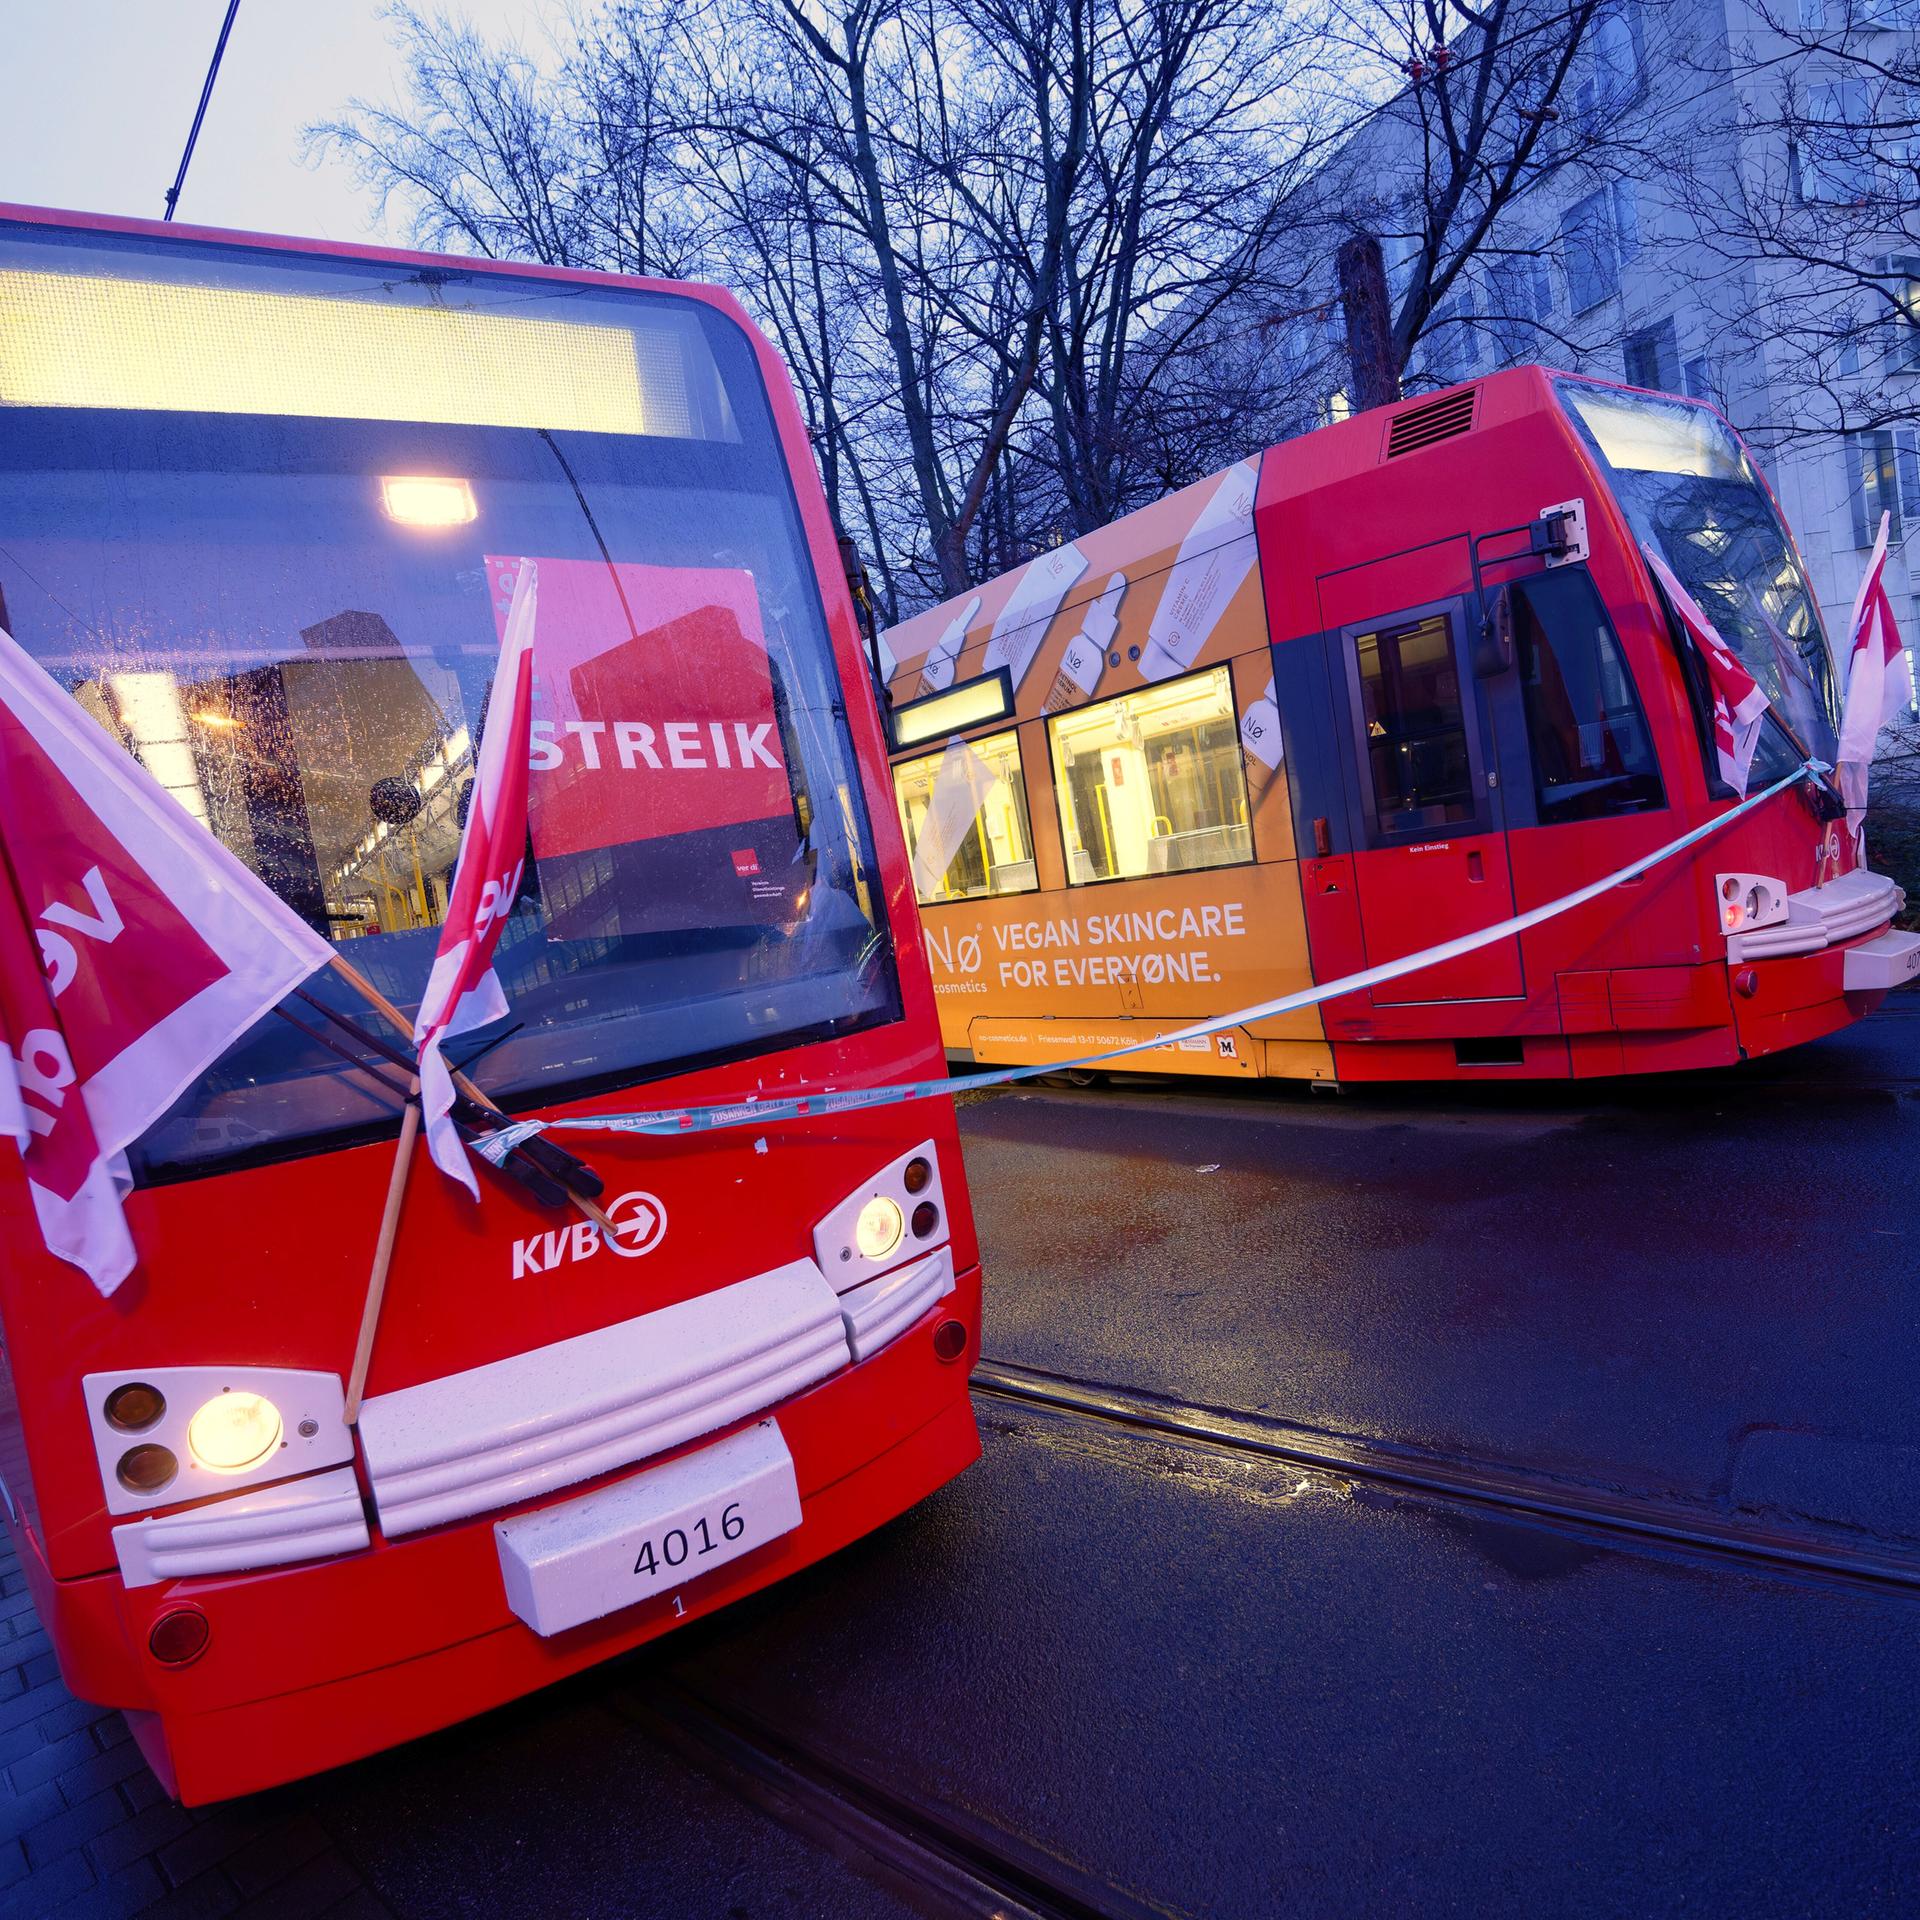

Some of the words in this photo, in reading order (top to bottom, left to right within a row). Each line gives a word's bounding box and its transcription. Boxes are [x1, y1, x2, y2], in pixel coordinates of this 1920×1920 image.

[528, 719, 784, 771] STREIK
[992, 918, 1081, 951] VEGAN
[1086, 903, 1246, 945] SKINCARE
[933, 979, 988, 994] cosmetics
[998, 960, 1049, 988] FOR
[1053, 951, 1222, 986] EVERYØNE.
[1096, 1035, 1120, 1045] 50672
[512, 1219, 600, 1280] KVB
[633, 1503, 745, 1576] 4016
[672, 1595, 688, 1618] 1
